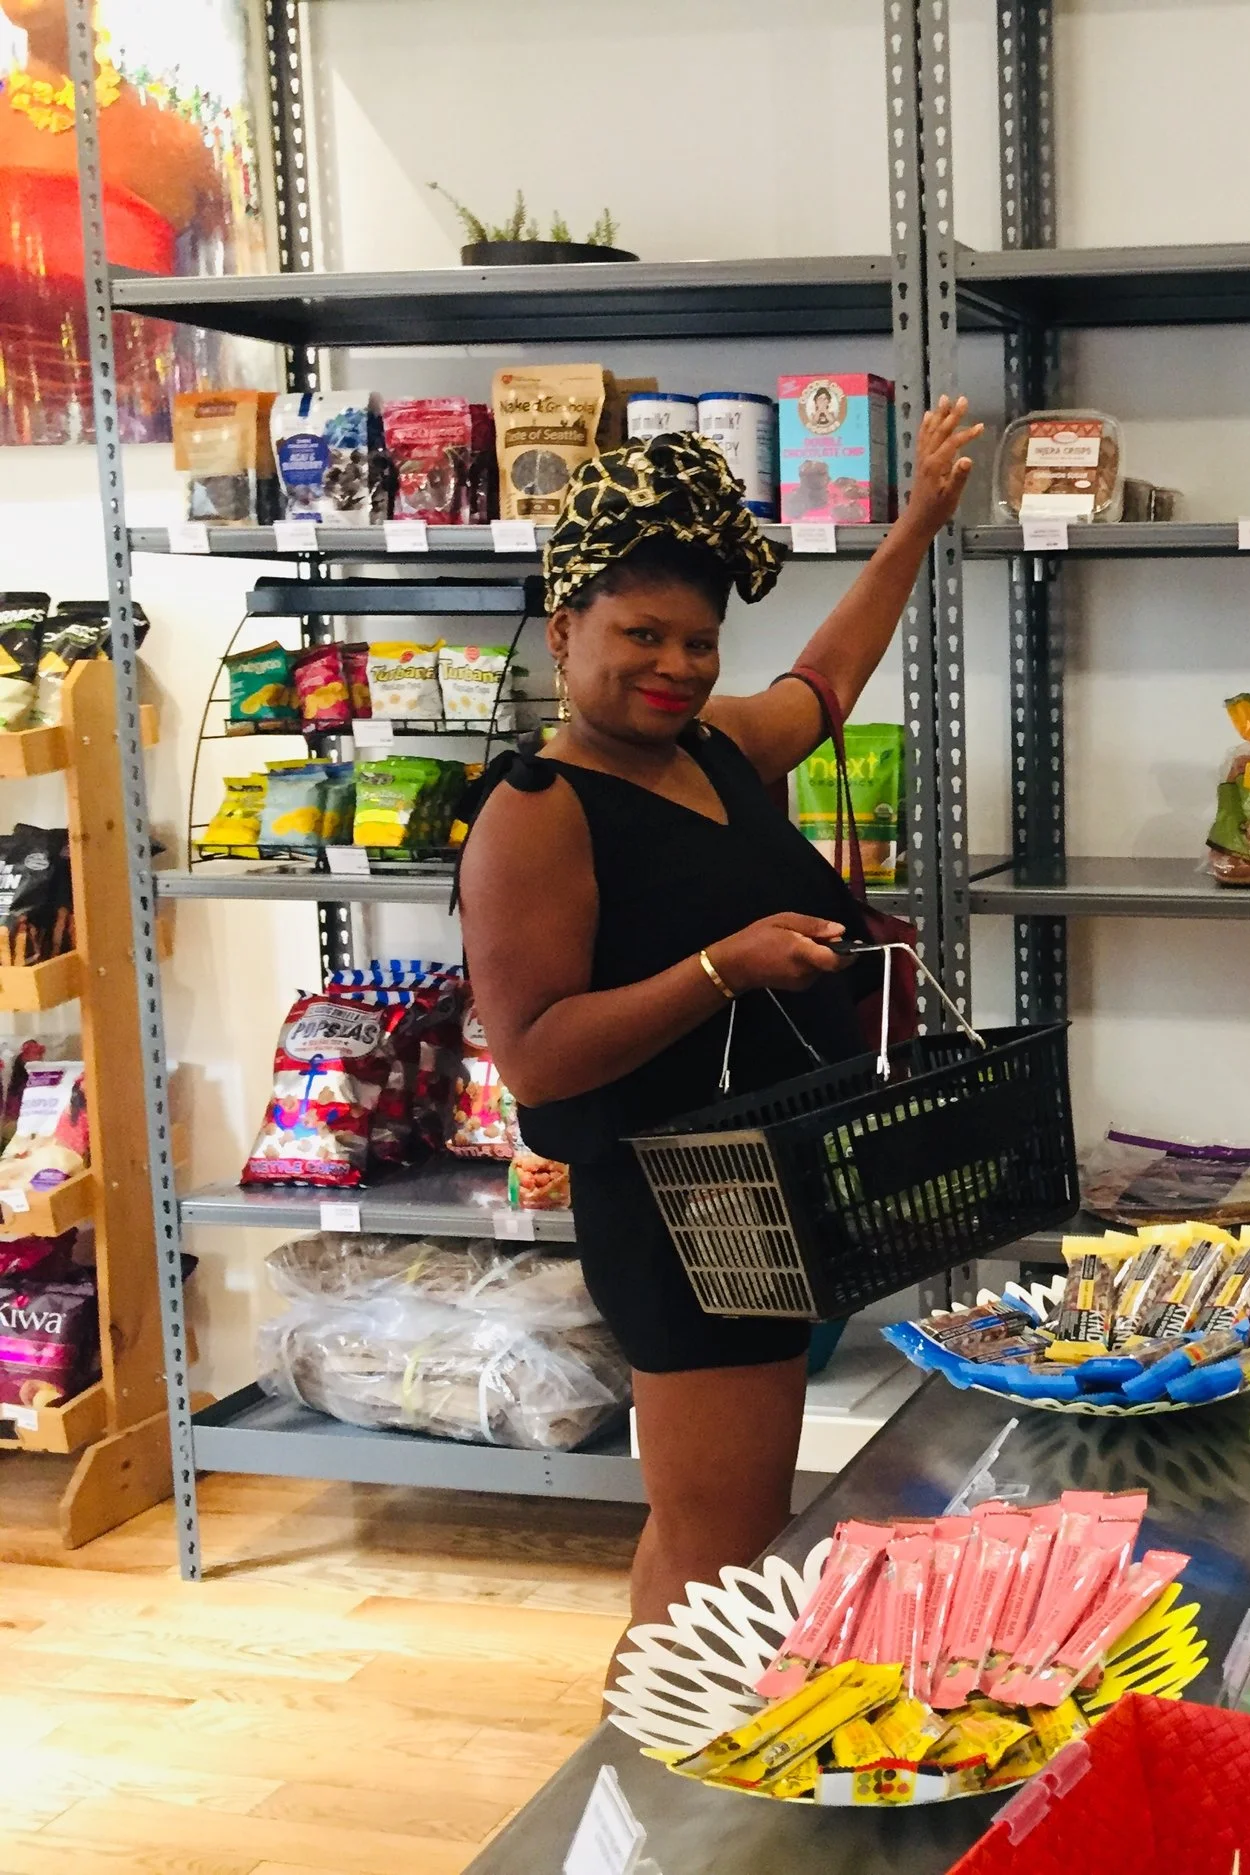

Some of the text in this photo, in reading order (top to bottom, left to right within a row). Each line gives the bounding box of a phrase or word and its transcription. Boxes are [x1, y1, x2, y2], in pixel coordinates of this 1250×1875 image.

[546, 400, 596, 414] Grnola
[543, 429, 585, 442] Seattle
[371, 663, 437, 684] Turbana
[250, 1159, 350, 1176] KETTLE CORN
[1086, 1312, 1105, 1343] KIND
[1162, 1304, 1191, 1339] KIND
[1213, 1306, 1240, 1331] KIN
[983, 1570, 998, 1603] LAYERED
[1019, 1563, 1035, 1599] LAYERED
[970, 1628, 980, 1644] BAR
[1006, 1620, 1018, 1637] BAR
